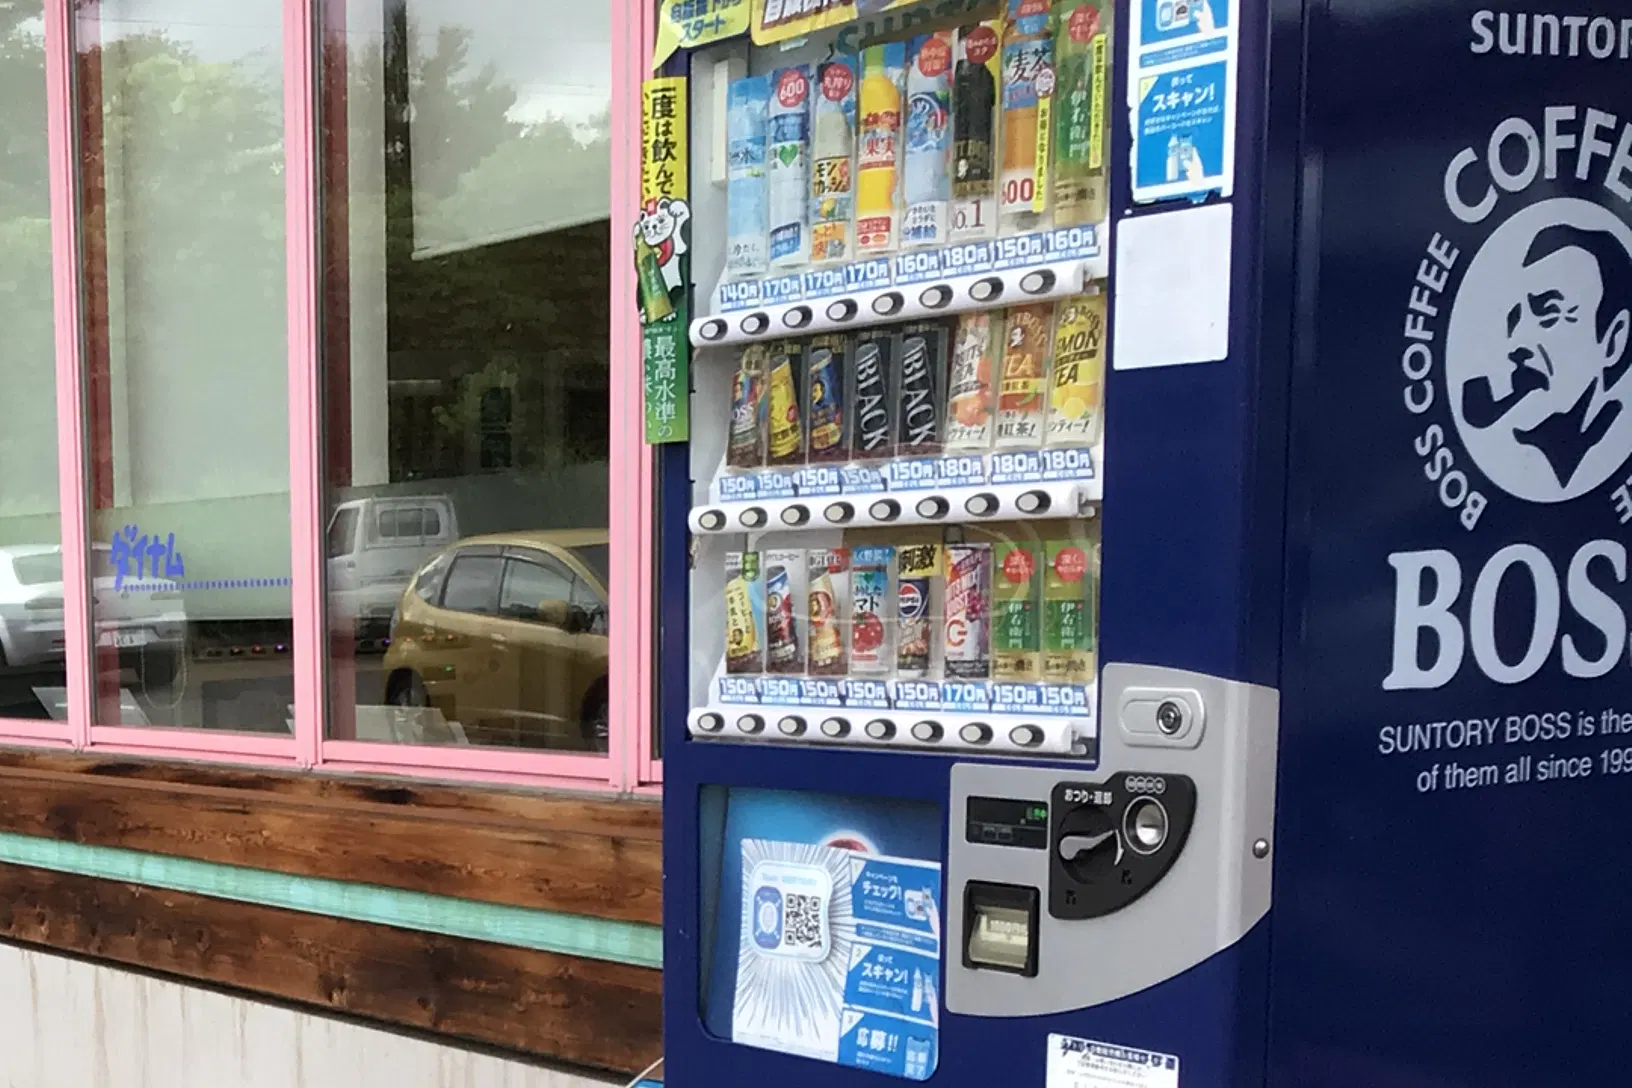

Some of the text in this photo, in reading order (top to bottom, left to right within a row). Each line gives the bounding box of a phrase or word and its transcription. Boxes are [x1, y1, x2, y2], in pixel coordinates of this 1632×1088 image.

[780, 79, 805, 101] 600
[651, 86, 677, 195] 一度は飲んで
[997, 238, 1042, 259] 150円
[1047, 229, 1093, 250] 160円
[897, 253, 938, 274] 160円
[944, 245, 988, 267] 180円
[808, 271, 843, 290] 170円
[848, 262, 887, 282] 170円
[722, 282, 758, 301] 140円
[764, 278, 799, 298] 170円
[654, 335, 676, 437] 最高水準の
[1402, 232, 1488, 531] BOSS COFFEE
[857, 356, 891, 450] BLACK
[903, 351, 937, 446] BLACK
[939, 458, 981, 477] 180円
[993, 454, 1038, 473] 180円
[1044, 450, 1090, 470] 180円
[800, 468, 837, 486] 150円
[842, 469, 882, 485] 150円
[892, 461, 932, 480] 150円
[722, 477, 754, 493] 150円
[758, 474, 791, 489] 150円
[1382, 539, 1632, 690] BOS
[720, 678, 754, 695] 150円
[762, 680, 798, 696] 150円
[800, 680, 838, 698] 150円
[847, 680, 886, 699] 150円
[897, 683, 938, 701] 150円
[946, 684, 986, 702] 170円
[993, 684, 1036, 704] 150円
[1040, 685, 1085, 705] 150円
[1379, 707, 1632, 754] SUNTORY BOSS is the
[1417, 763, 1440, 792] of
[1445, 762, 1498, 789] them
[1504, 755, 1531, 784] all
[1537, 753, 1592, 780] since
